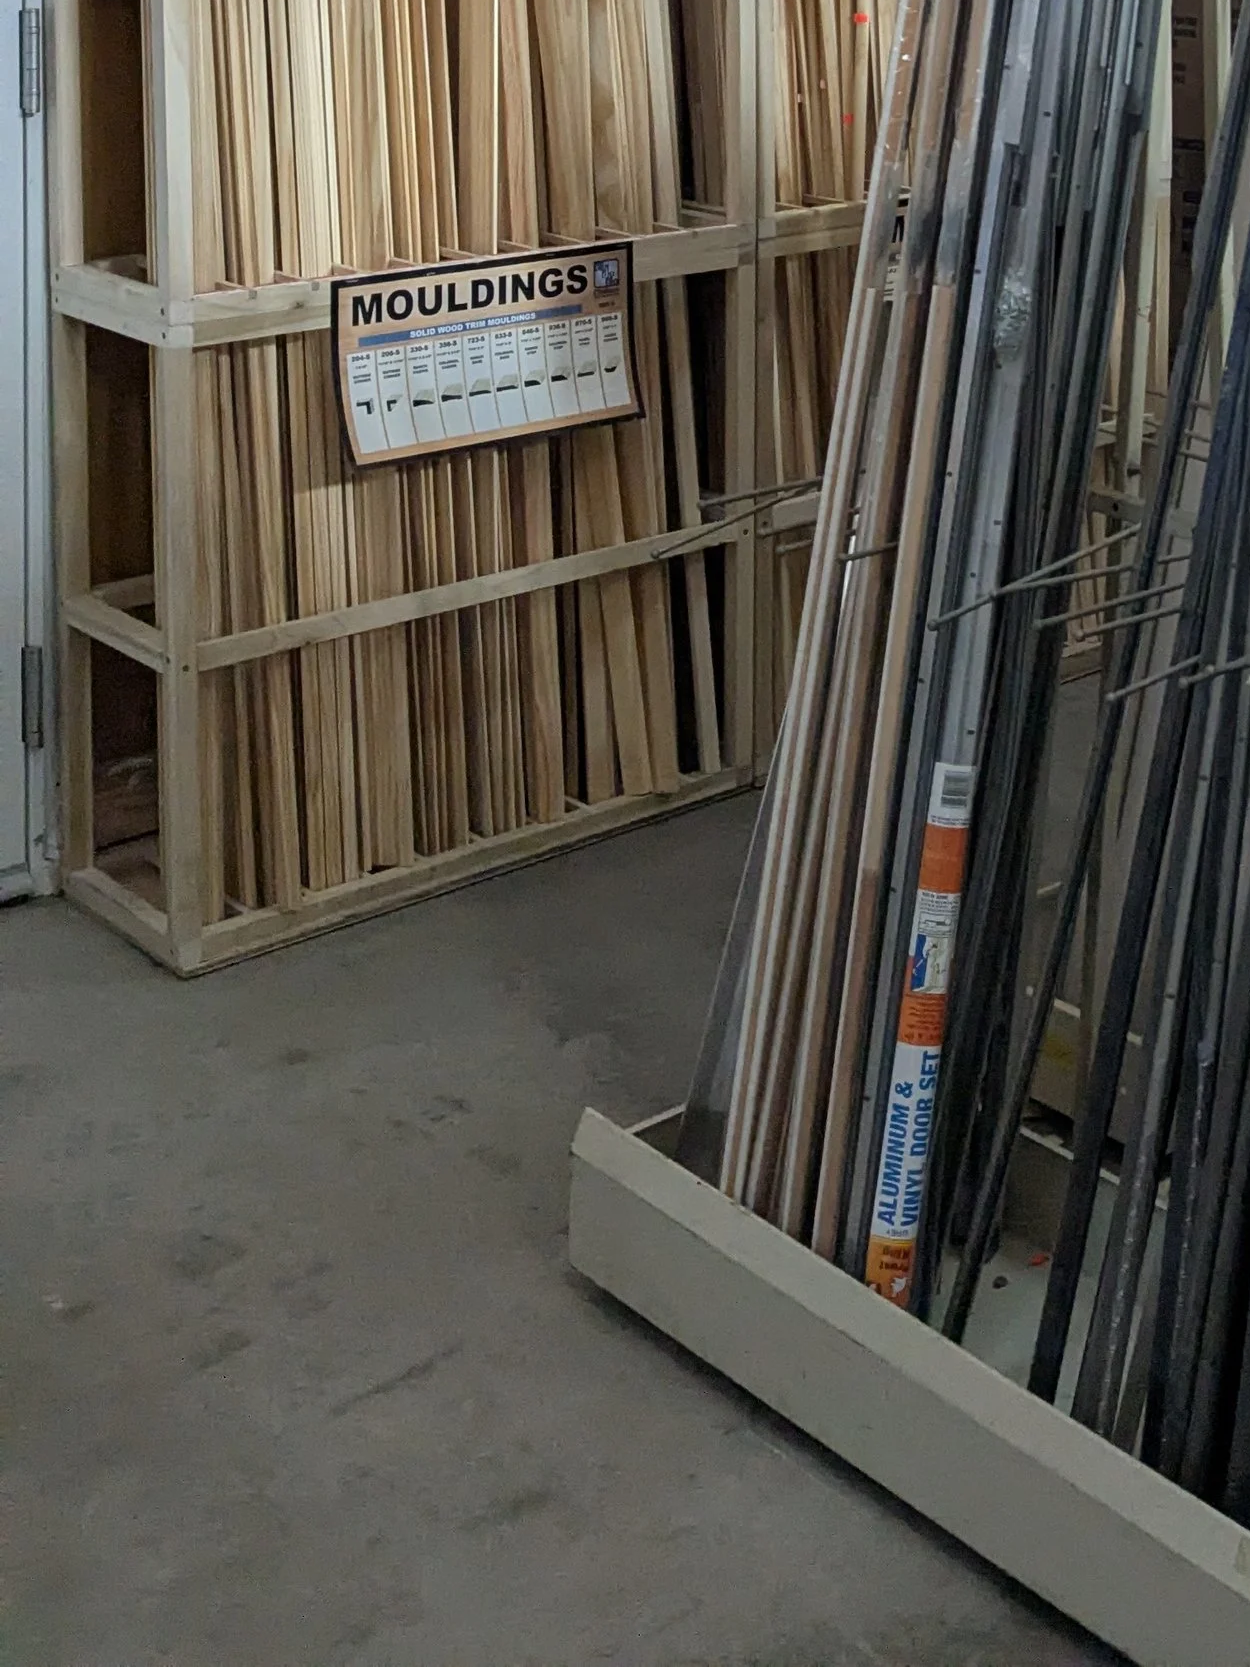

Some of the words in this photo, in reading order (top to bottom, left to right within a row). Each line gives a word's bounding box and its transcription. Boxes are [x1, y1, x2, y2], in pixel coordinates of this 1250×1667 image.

[352, 264, 588, 327] MOULDINGS
[409, 327, 436, 339] SOLID
[437, 323, 464, 335] WOOD
[465, 319, 486, 331] TRIM
[487, 312, 537, 327] MOULDINGS
[918, 1050, 942, 1091] SET
[876, 1101, 911, 1227] ALUMINUM
[894, 1079, 914, 1099] &
[910, 1097, 935, 1157] DOOR
